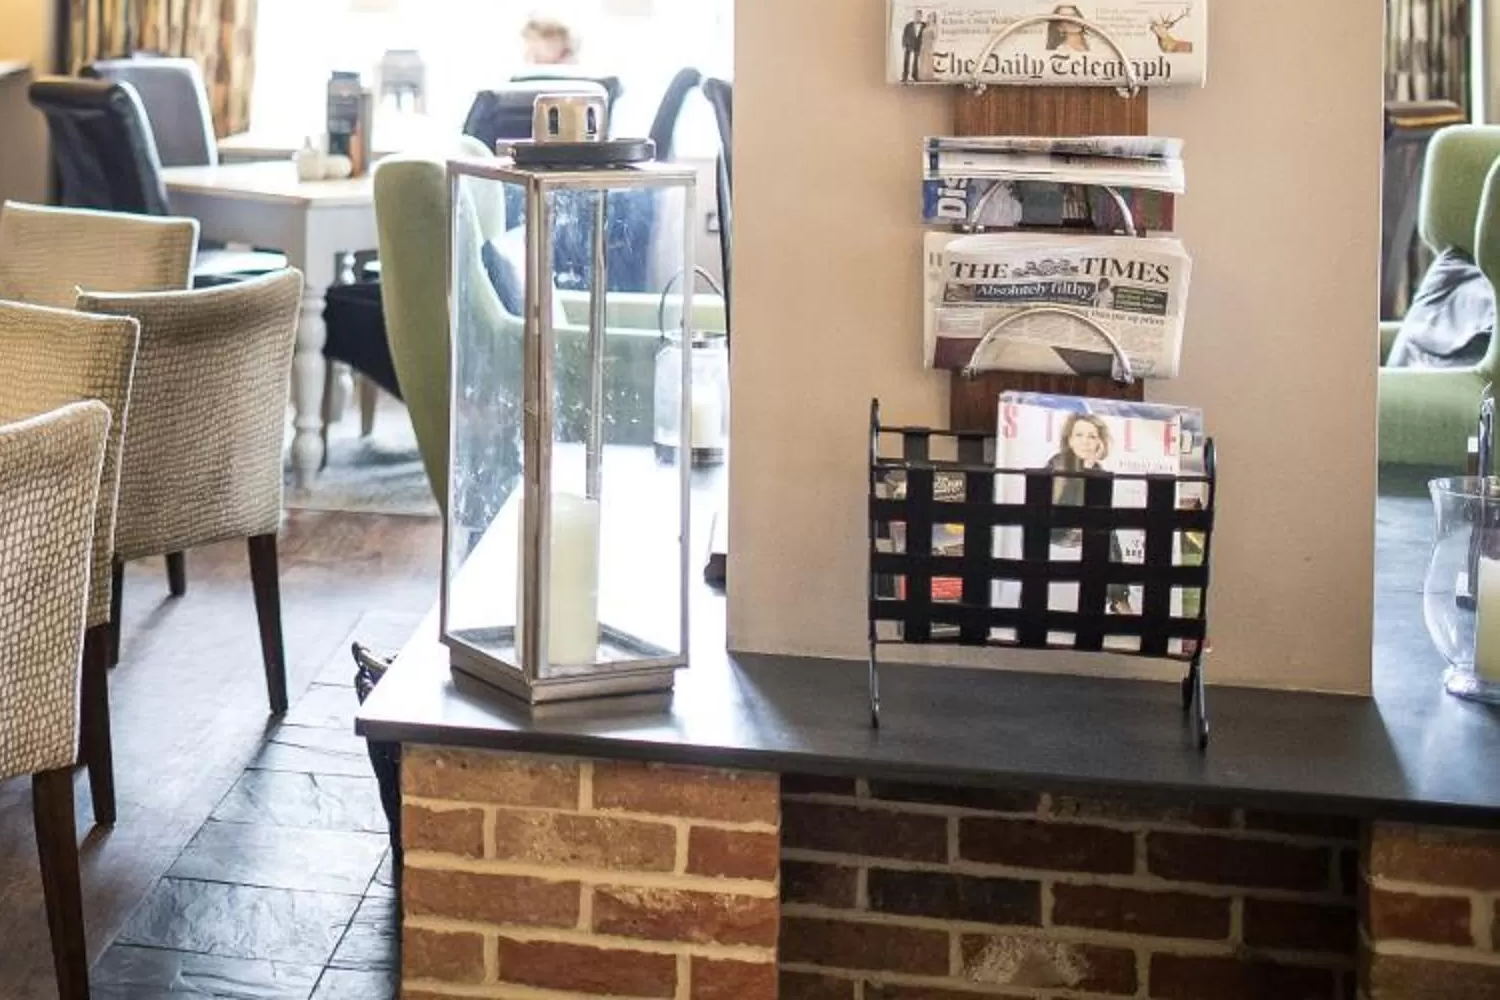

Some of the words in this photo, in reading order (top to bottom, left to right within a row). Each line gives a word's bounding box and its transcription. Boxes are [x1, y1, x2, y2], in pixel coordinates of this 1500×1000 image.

[932, 51, 976, 76] The
[981, 51, 1045, 79] Daily
[1049, 53, 1171, 81] Telegraph
[950, 261, 1008, 279] THE
[1080, 257, 1170, 285] TIMES
[977, 282, 1048, 298] Absolutely
[1049, 280, 1092, 299] filthy
